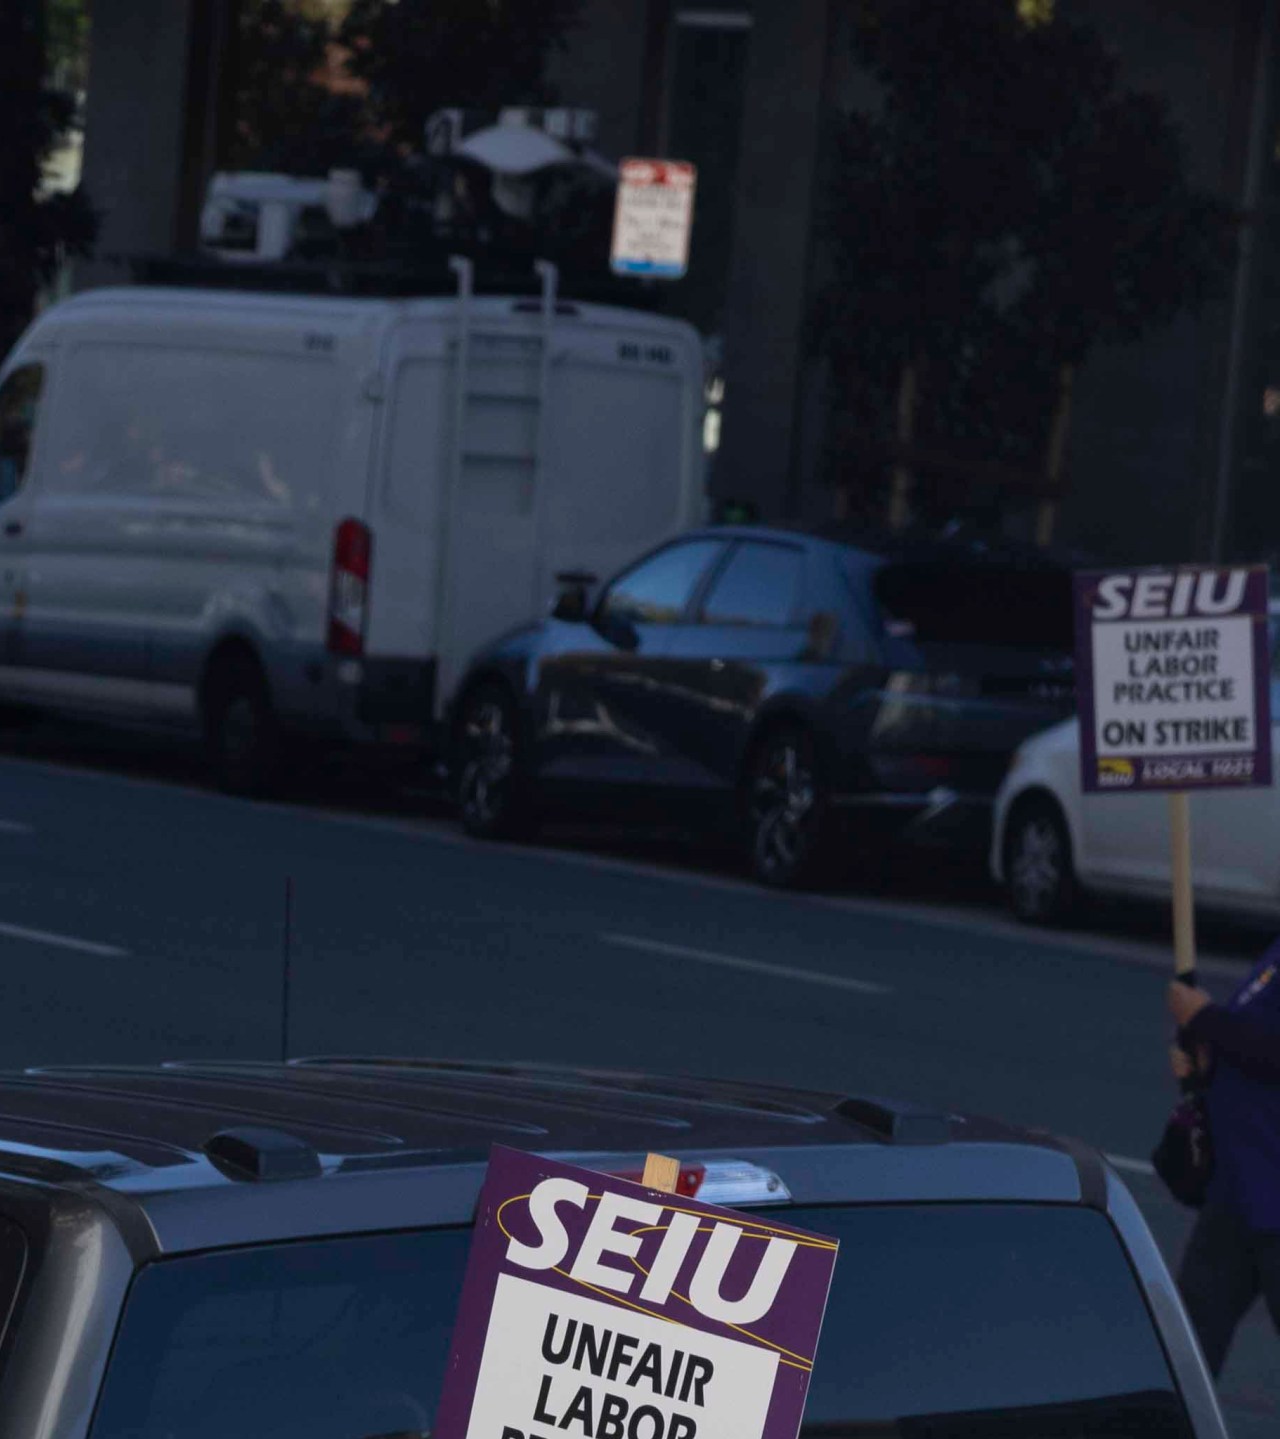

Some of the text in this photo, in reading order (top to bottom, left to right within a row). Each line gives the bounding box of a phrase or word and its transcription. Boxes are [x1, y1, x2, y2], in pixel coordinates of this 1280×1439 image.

[1094, 571, 1245, 617] SEIU
[1124, 629, 1218, 652] UNFAIR
[1129, 655, 1217, 677] LABOR
[1114, 679, 1233, 703] PRACTICE
[1102, 717, 1247, 746] ON STRIKE
[503, 1177, 795, 1324] SEIU
[542, 1313, 711, 1406] UNFAIR
